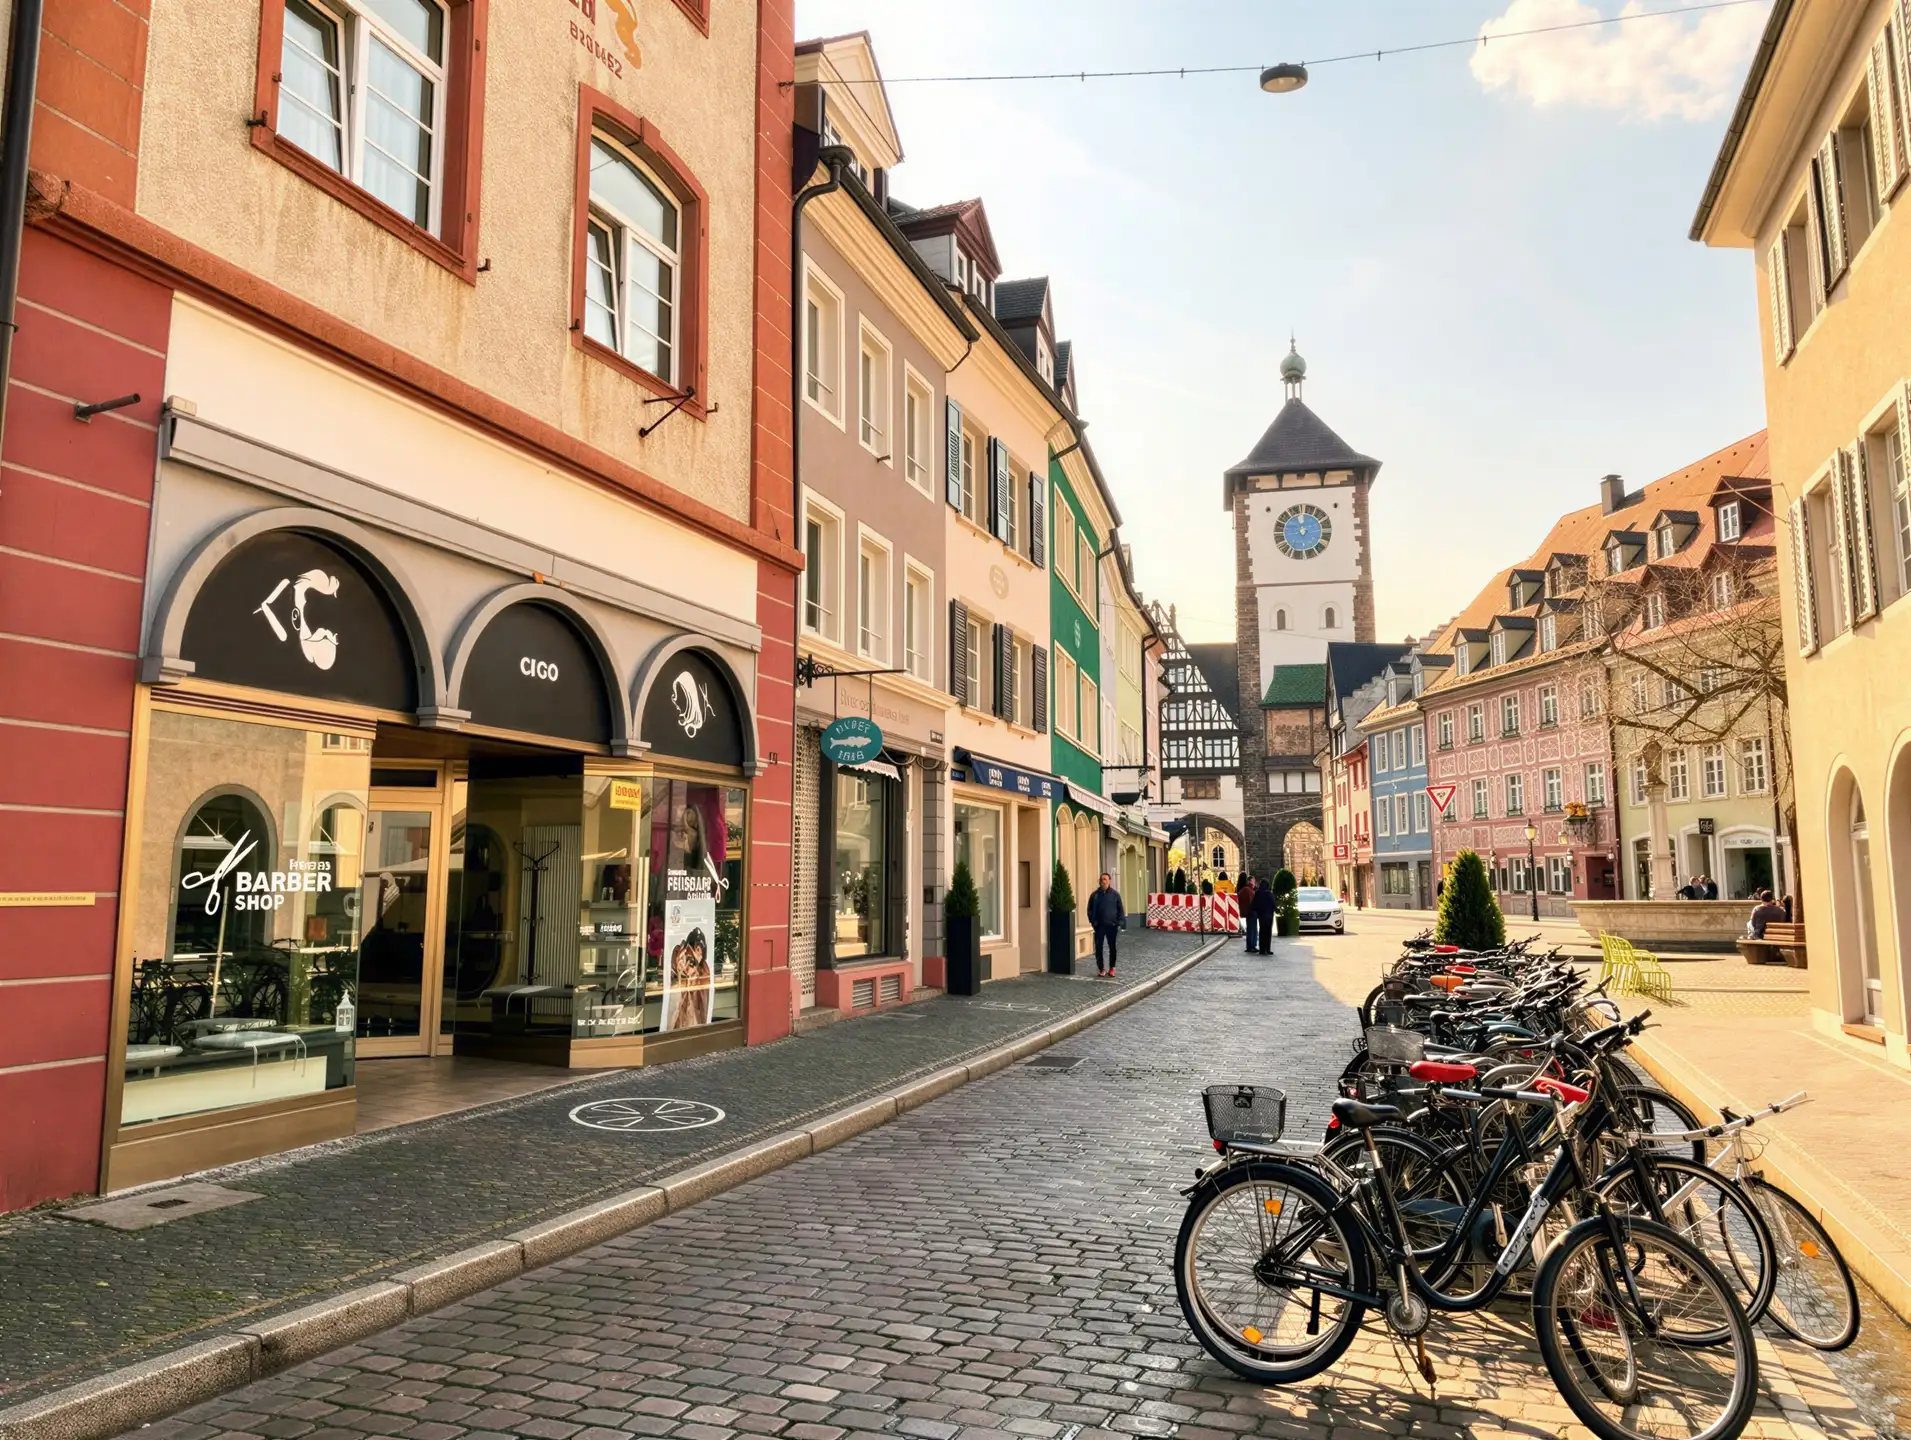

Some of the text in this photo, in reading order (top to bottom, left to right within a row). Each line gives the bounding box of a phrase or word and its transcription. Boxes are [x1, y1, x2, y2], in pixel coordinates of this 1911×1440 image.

[520, 656, 559, 682] CIGO
[236, 871, 332, 893] BARBER
[234, 894, 285, 911] SHOP
